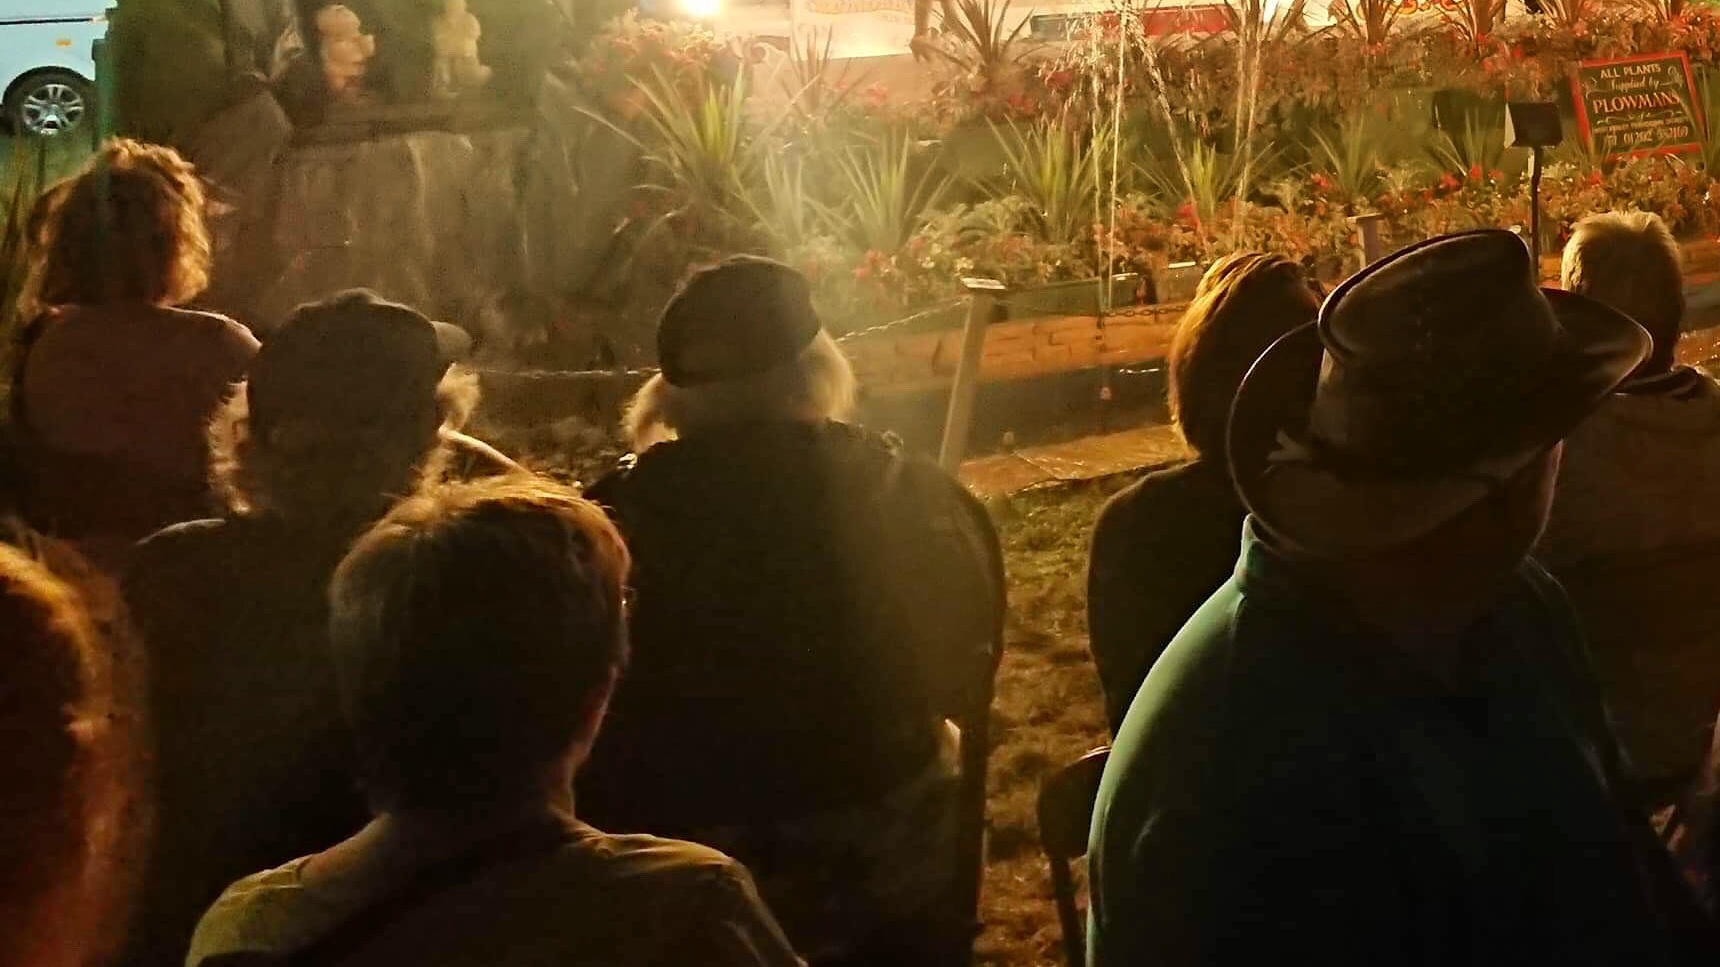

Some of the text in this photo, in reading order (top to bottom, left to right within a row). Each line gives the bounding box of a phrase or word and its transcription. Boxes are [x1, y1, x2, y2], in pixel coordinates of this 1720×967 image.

[1600, 63, 1661, 80] ALL PLANTS
[1648, 75, 1660, 91] by
[1592, 92, 1681, 114] PLOWMANS
